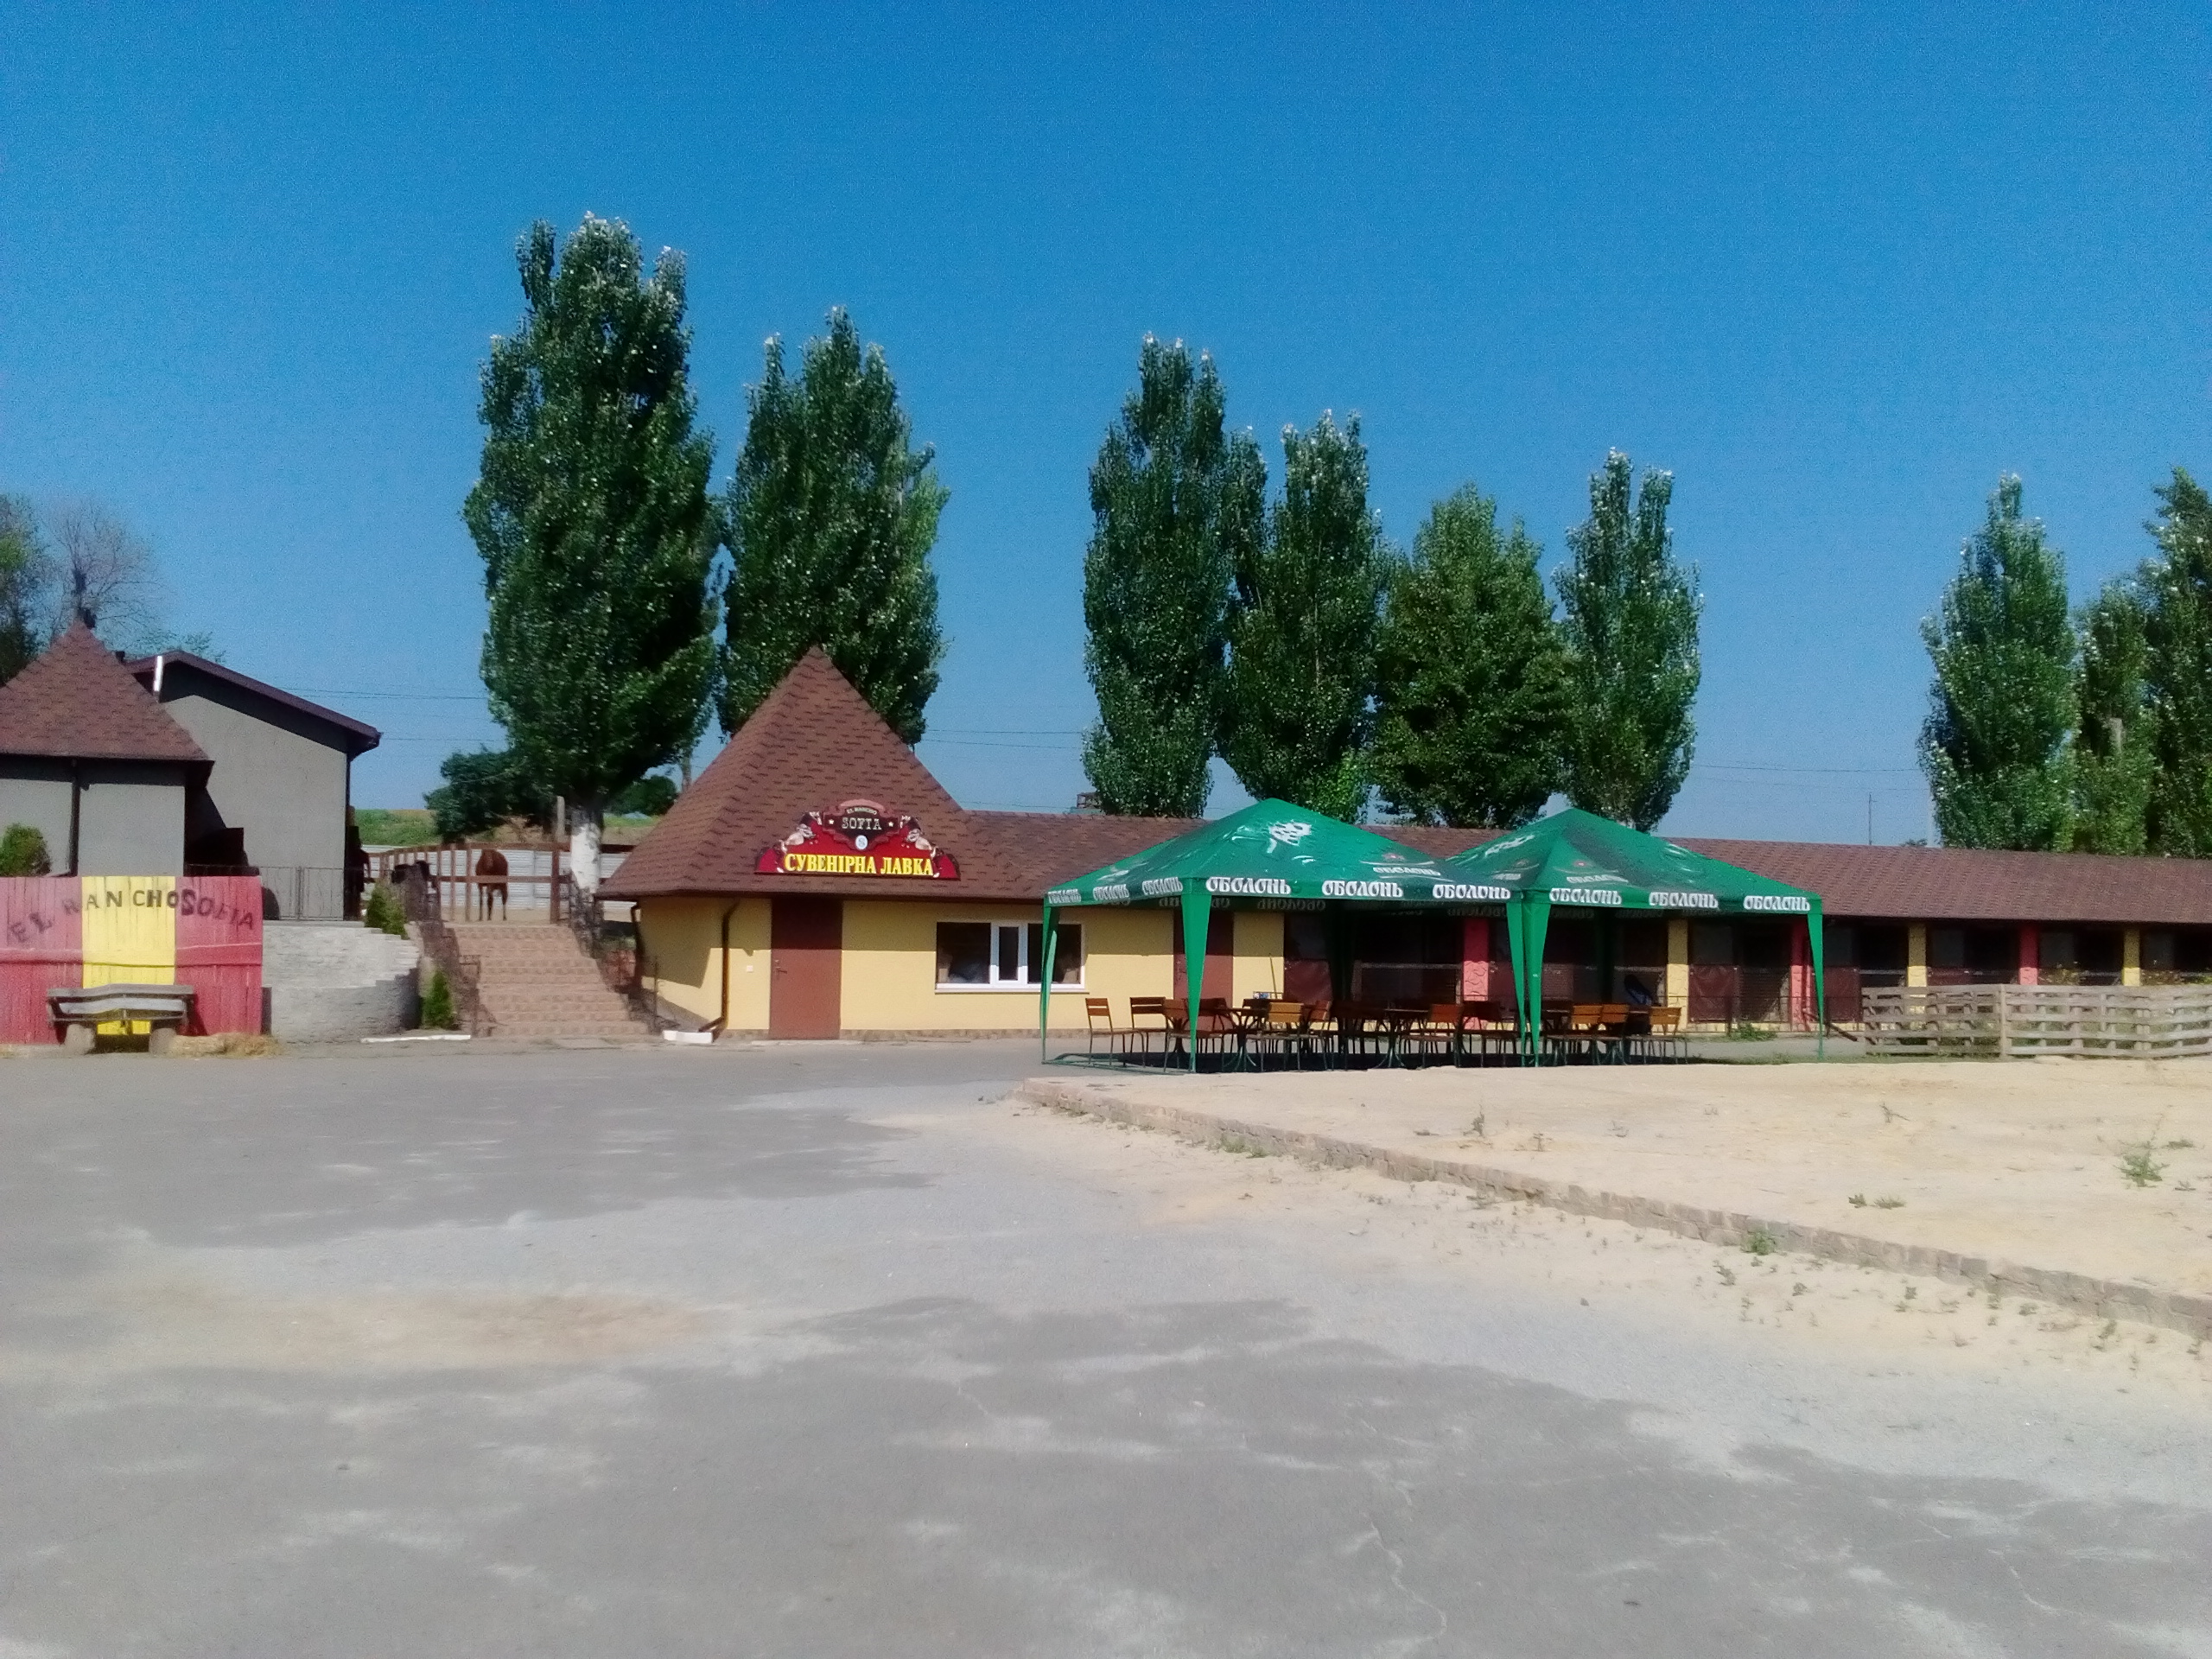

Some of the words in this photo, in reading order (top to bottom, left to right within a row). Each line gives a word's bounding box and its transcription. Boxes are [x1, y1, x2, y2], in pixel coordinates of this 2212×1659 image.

[784, 853, 877, 874] СУВЕНІРНА
[880, 857, 934, 876] ЛАВКА
[1205, 876, 1292, 895] ОБОЛОНЬ
[1321, 880, 1404, 898] ОБОЛОНЬ
[1432, 884, 1511, 899] ОБОЛОНЬ
[1549, 887, 1623, 905] ОБОЛОНЬ
[1649, 892, 1719, 908] ОБОЛОНЬ
[1743, 895, 1811, 912] ОБОЛОНЬ
[62, 889, 179, 916] RANCHO
